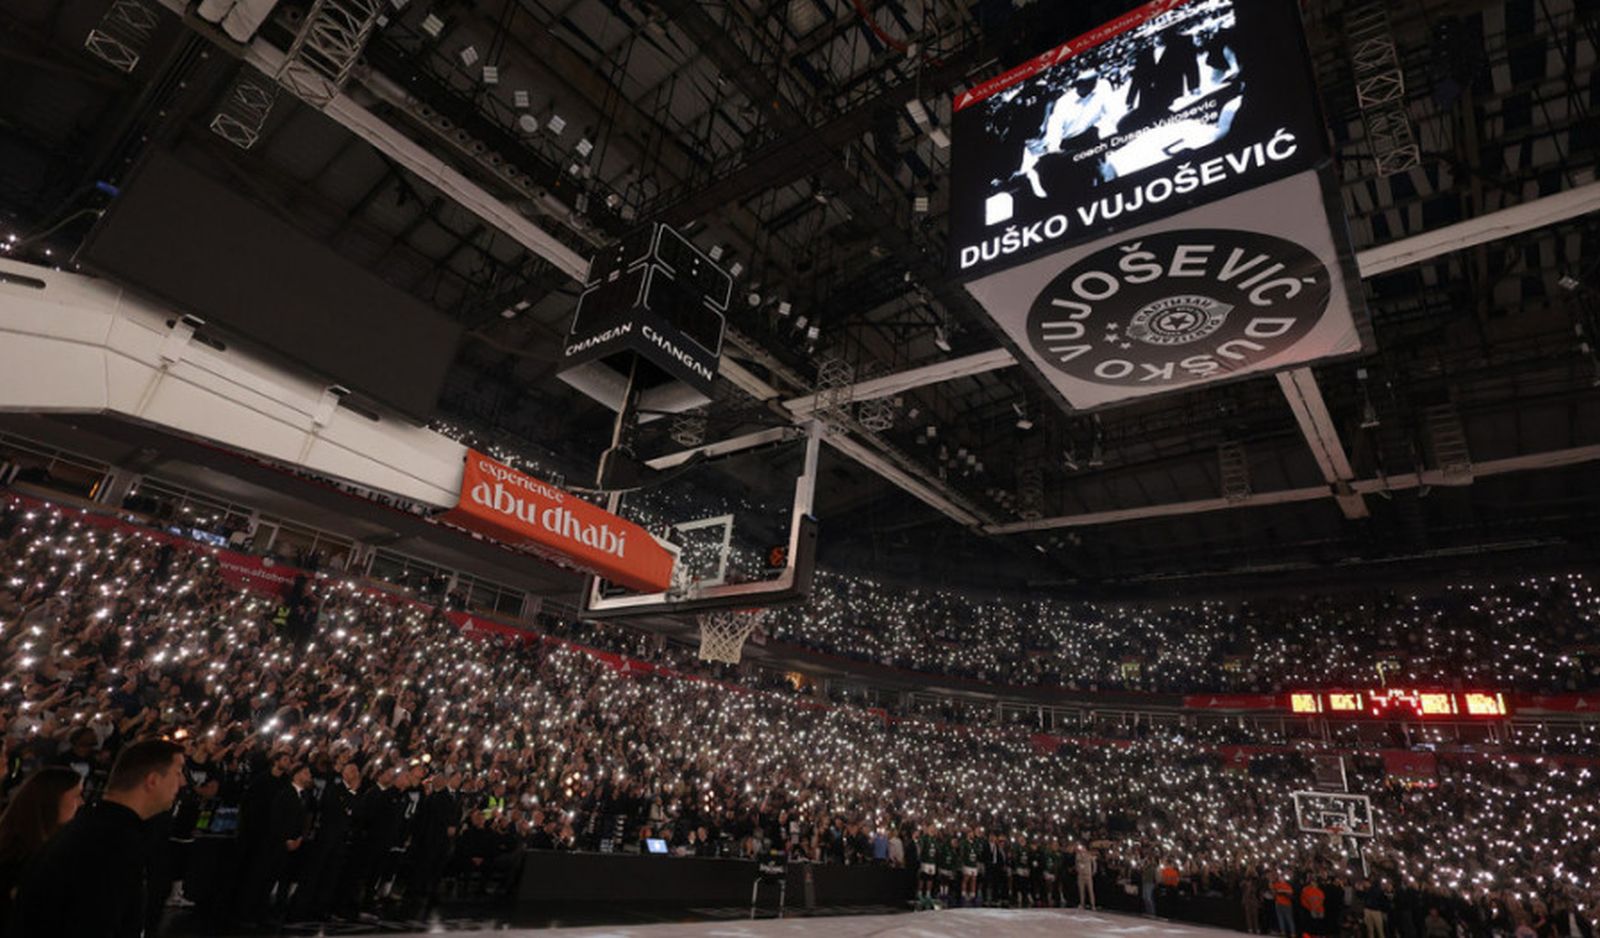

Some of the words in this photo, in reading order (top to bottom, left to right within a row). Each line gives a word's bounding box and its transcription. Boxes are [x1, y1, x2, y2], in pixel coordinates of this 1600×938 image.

[1072, 144, 1108, 162] coach
[960, 213, 1069, 270] DUŠKO
[1077, 127, 1299, 228] VUJOŠEVIĆ
[1041, 241, 1317, 363] VUJOŠEVIĆ
[564, 321, 633, 357] CHANGAN
[641, 324, 713, 381] CHANGAN
[1094, 315, 1297, 384] DUŠKO
[478, 458, 565, 504] experience
[471, 483, 536, 526] abu
[542, 505, 626, 559] dhabi
